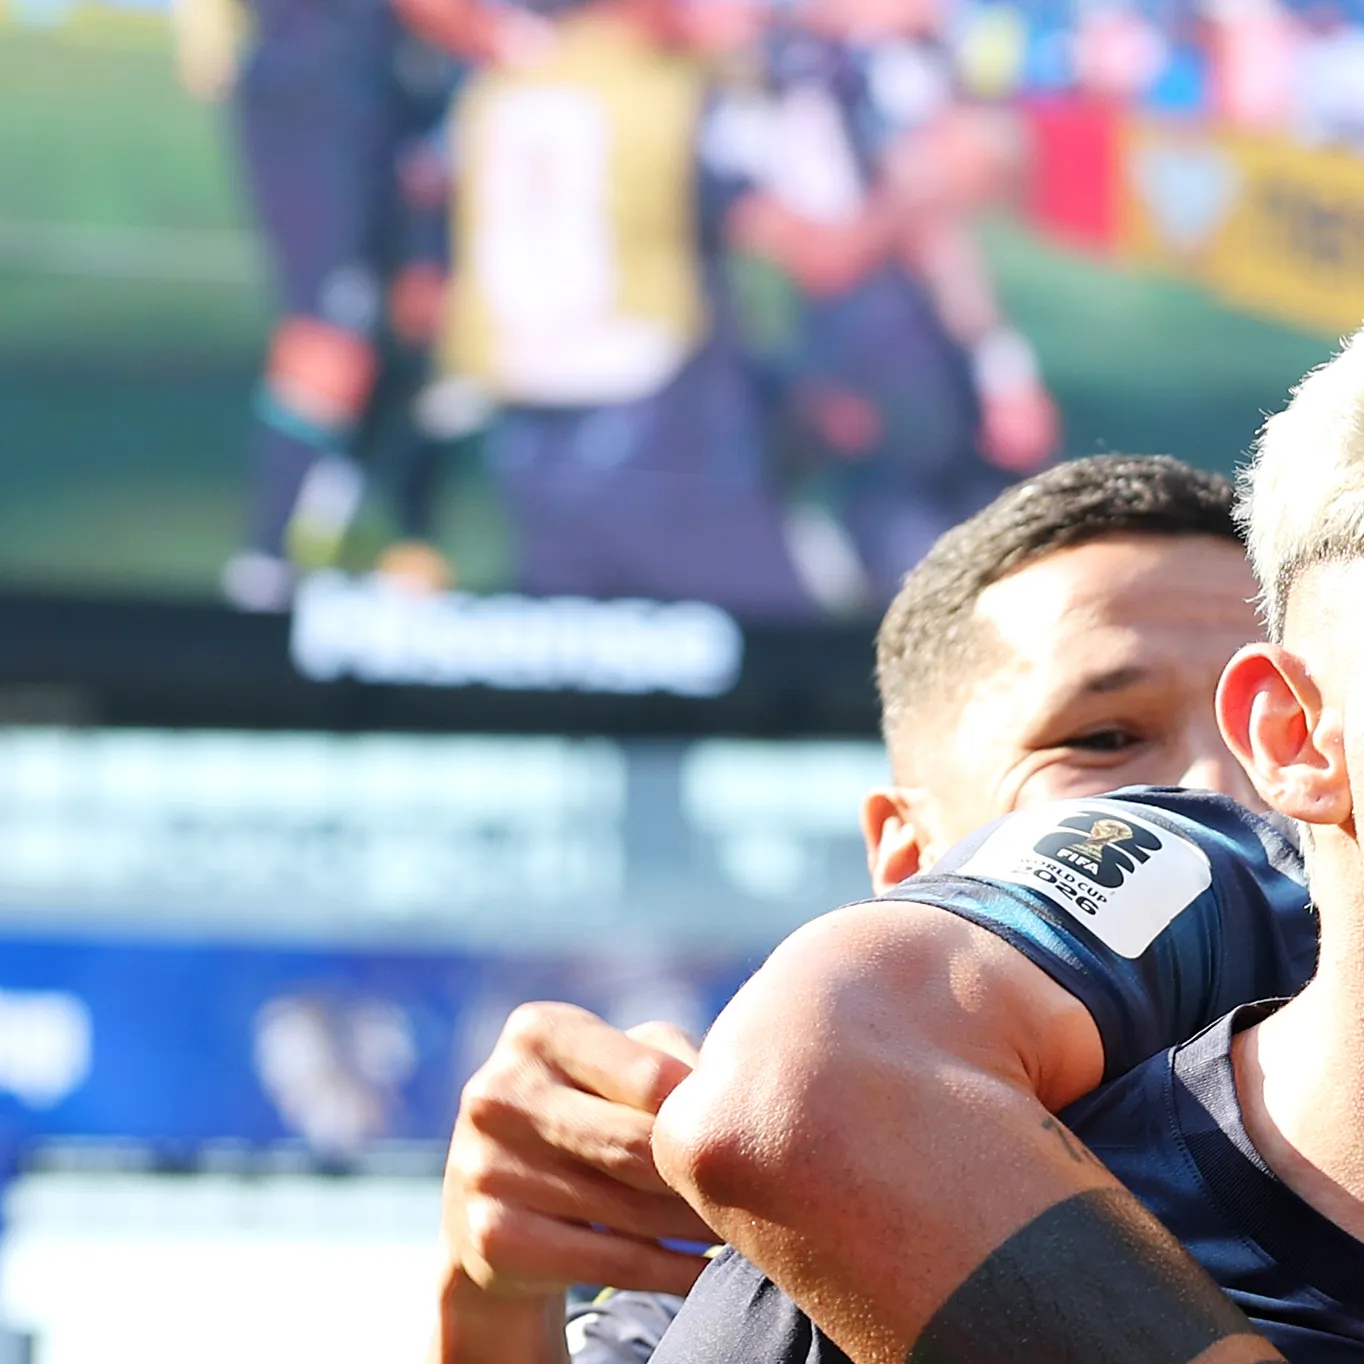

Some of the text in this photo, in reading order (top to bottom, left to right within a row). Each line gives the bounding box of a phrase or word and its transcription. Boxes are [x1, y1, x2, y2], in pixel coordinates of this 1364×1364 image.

[1056, 848, 1101, 877] FIFA
[1011, 864, 1100, 916] 2026
[1078, 879, 1108, 904] CUP
